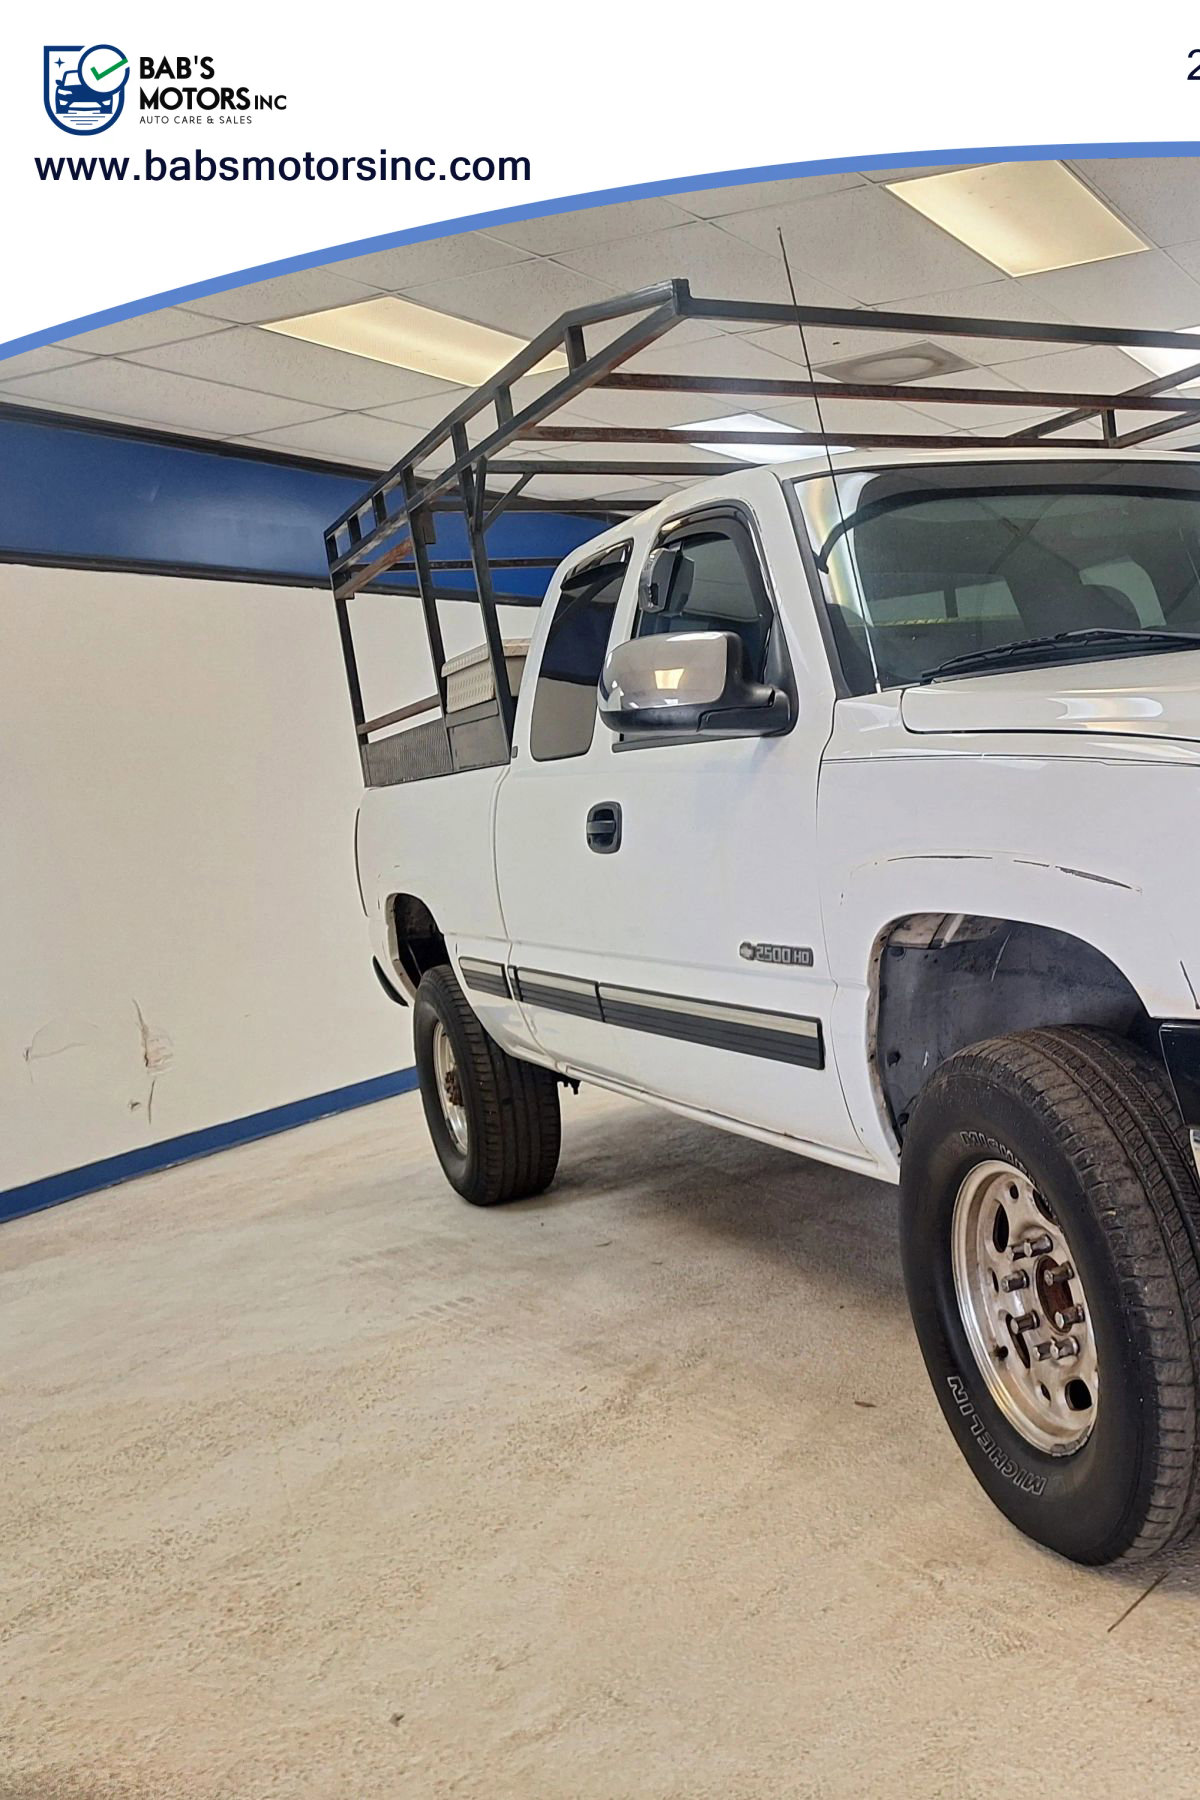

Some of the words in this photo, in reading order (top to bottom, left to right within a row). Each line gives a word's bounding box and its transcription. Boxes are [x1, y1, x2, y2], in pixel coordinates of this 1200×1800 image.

[756, 945, 791, 964] 2500
[793, 948, 811, 965] HD
[946, 1375, 1048, 1496] MICHELIN
